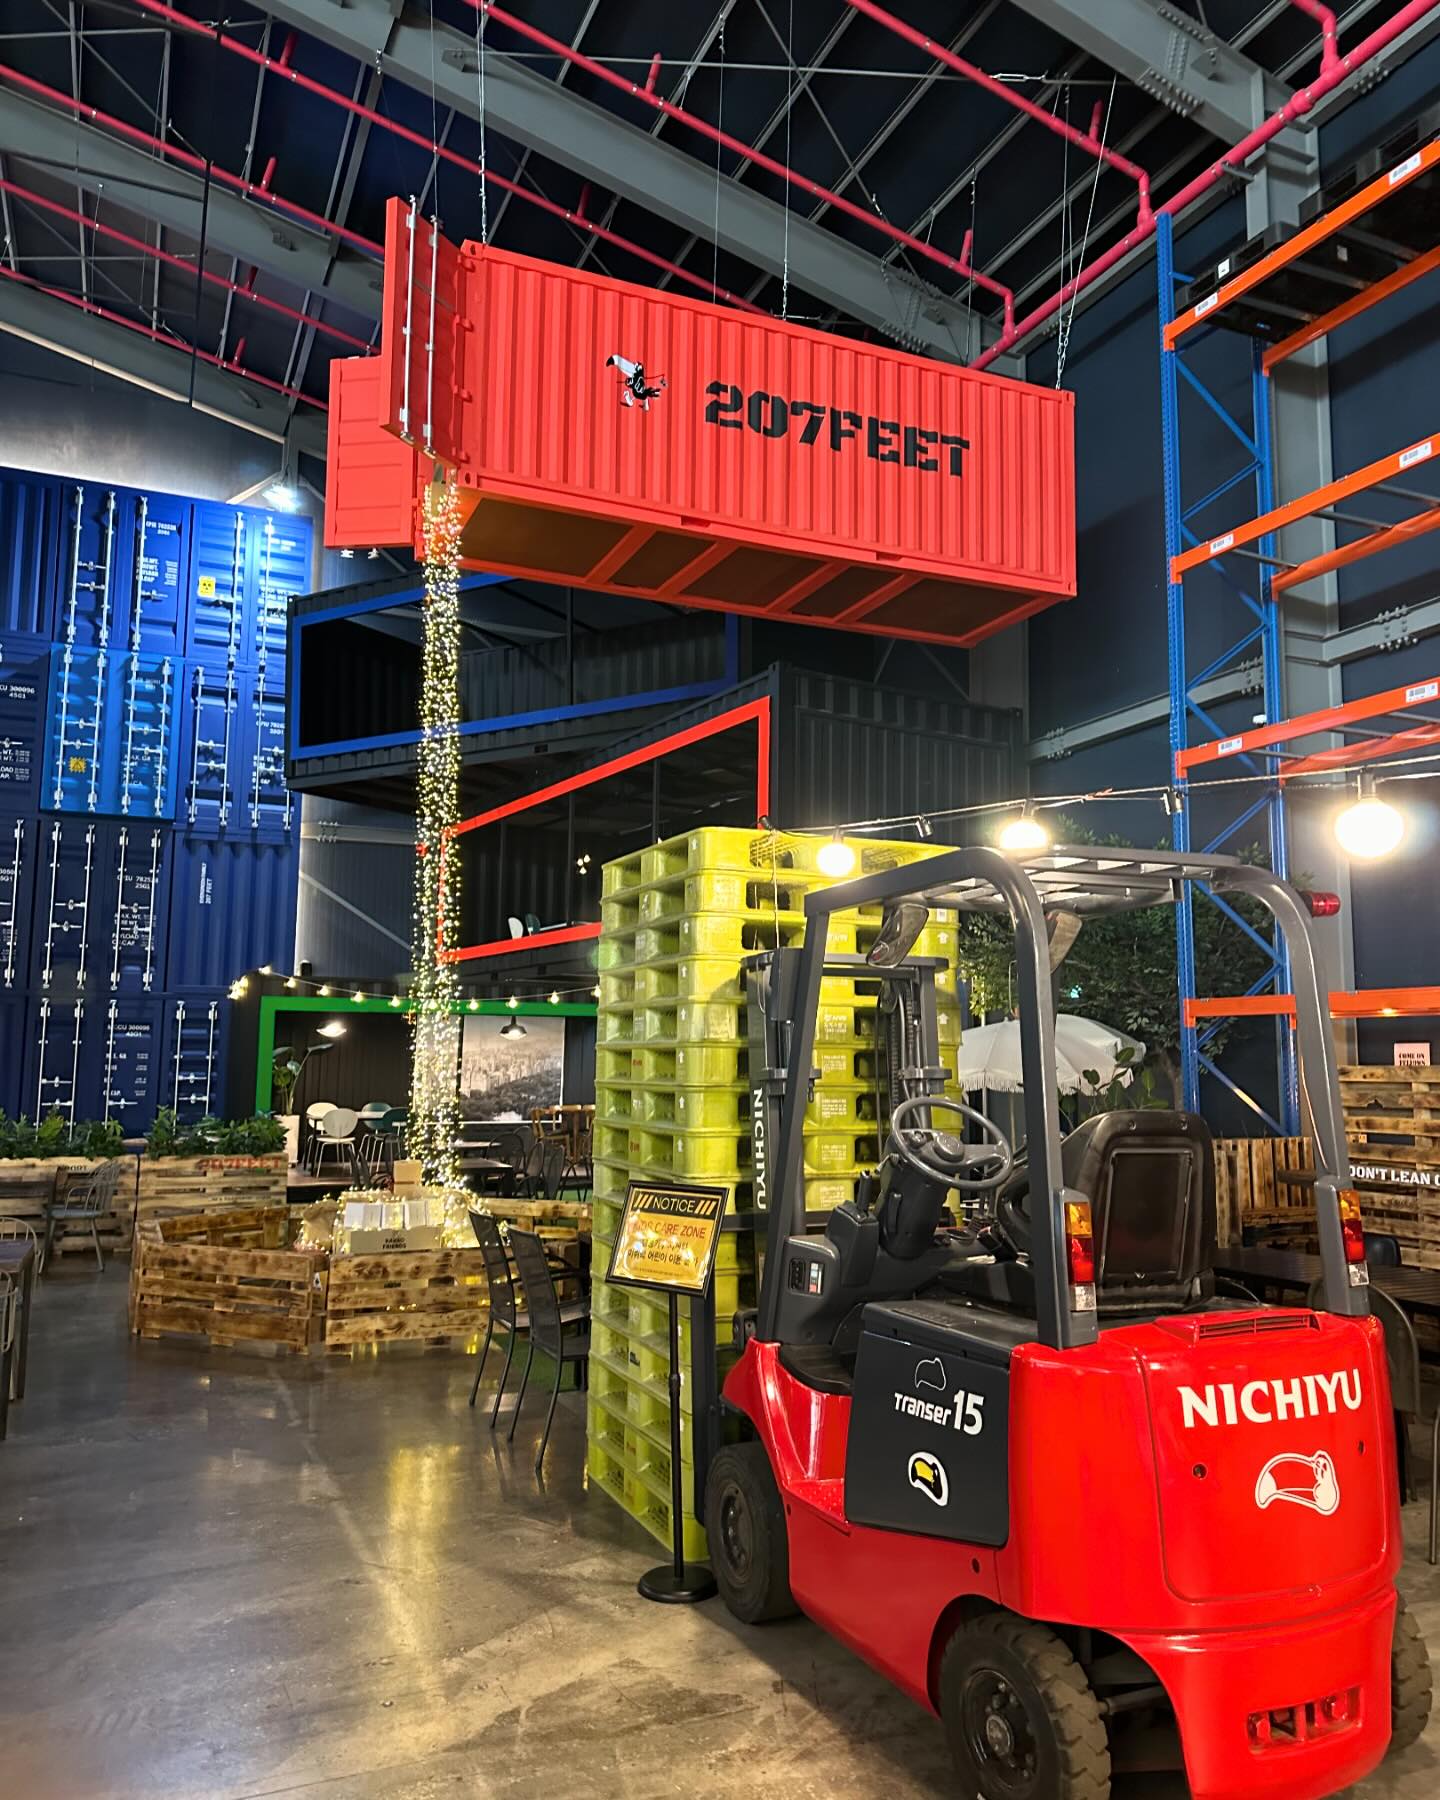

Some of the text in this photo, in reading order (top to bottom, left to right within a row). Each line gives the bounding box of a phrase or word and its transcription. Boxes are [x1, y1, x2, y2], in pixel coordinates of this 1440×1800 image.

[704, 380, 970, 478] 207FEET
[753, 1087, 767, 1210] NICHIYU
[1390, 1169, 1431, 1185] LEAN
[652, 1196, 696, 1213] NOTICE
[680, 1225, 707, 1239] ZONE
[894, 1389, 985, 1435] Transer 15
[1177, 1369, 1362, 1428] NICHIYU
